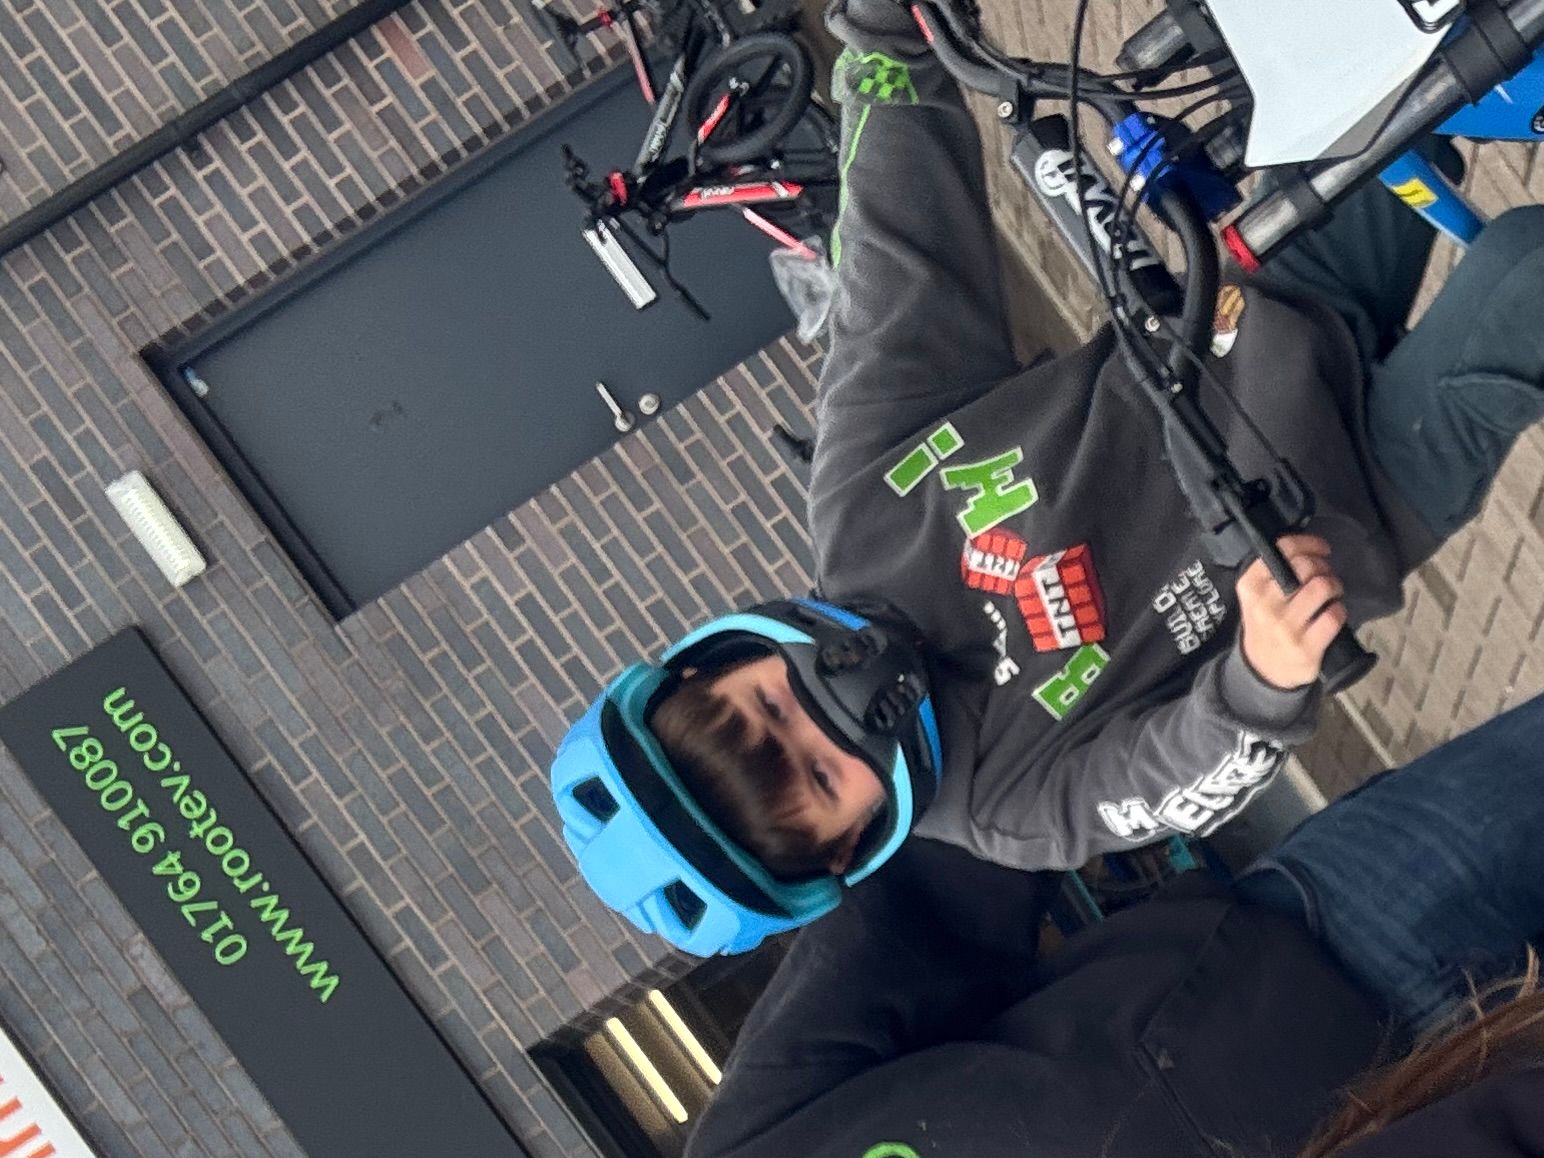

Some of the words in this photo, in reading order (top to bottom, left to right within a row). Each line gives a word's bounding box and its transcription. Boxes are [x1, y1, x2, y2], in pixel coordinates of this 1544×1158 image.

[1041, 577, 1077, 639] TNT
[52, 727, 166, 854] 910087
[103, 688, 340, 1001] www.rootev.com
[153, 851, 247, 965] 01764
